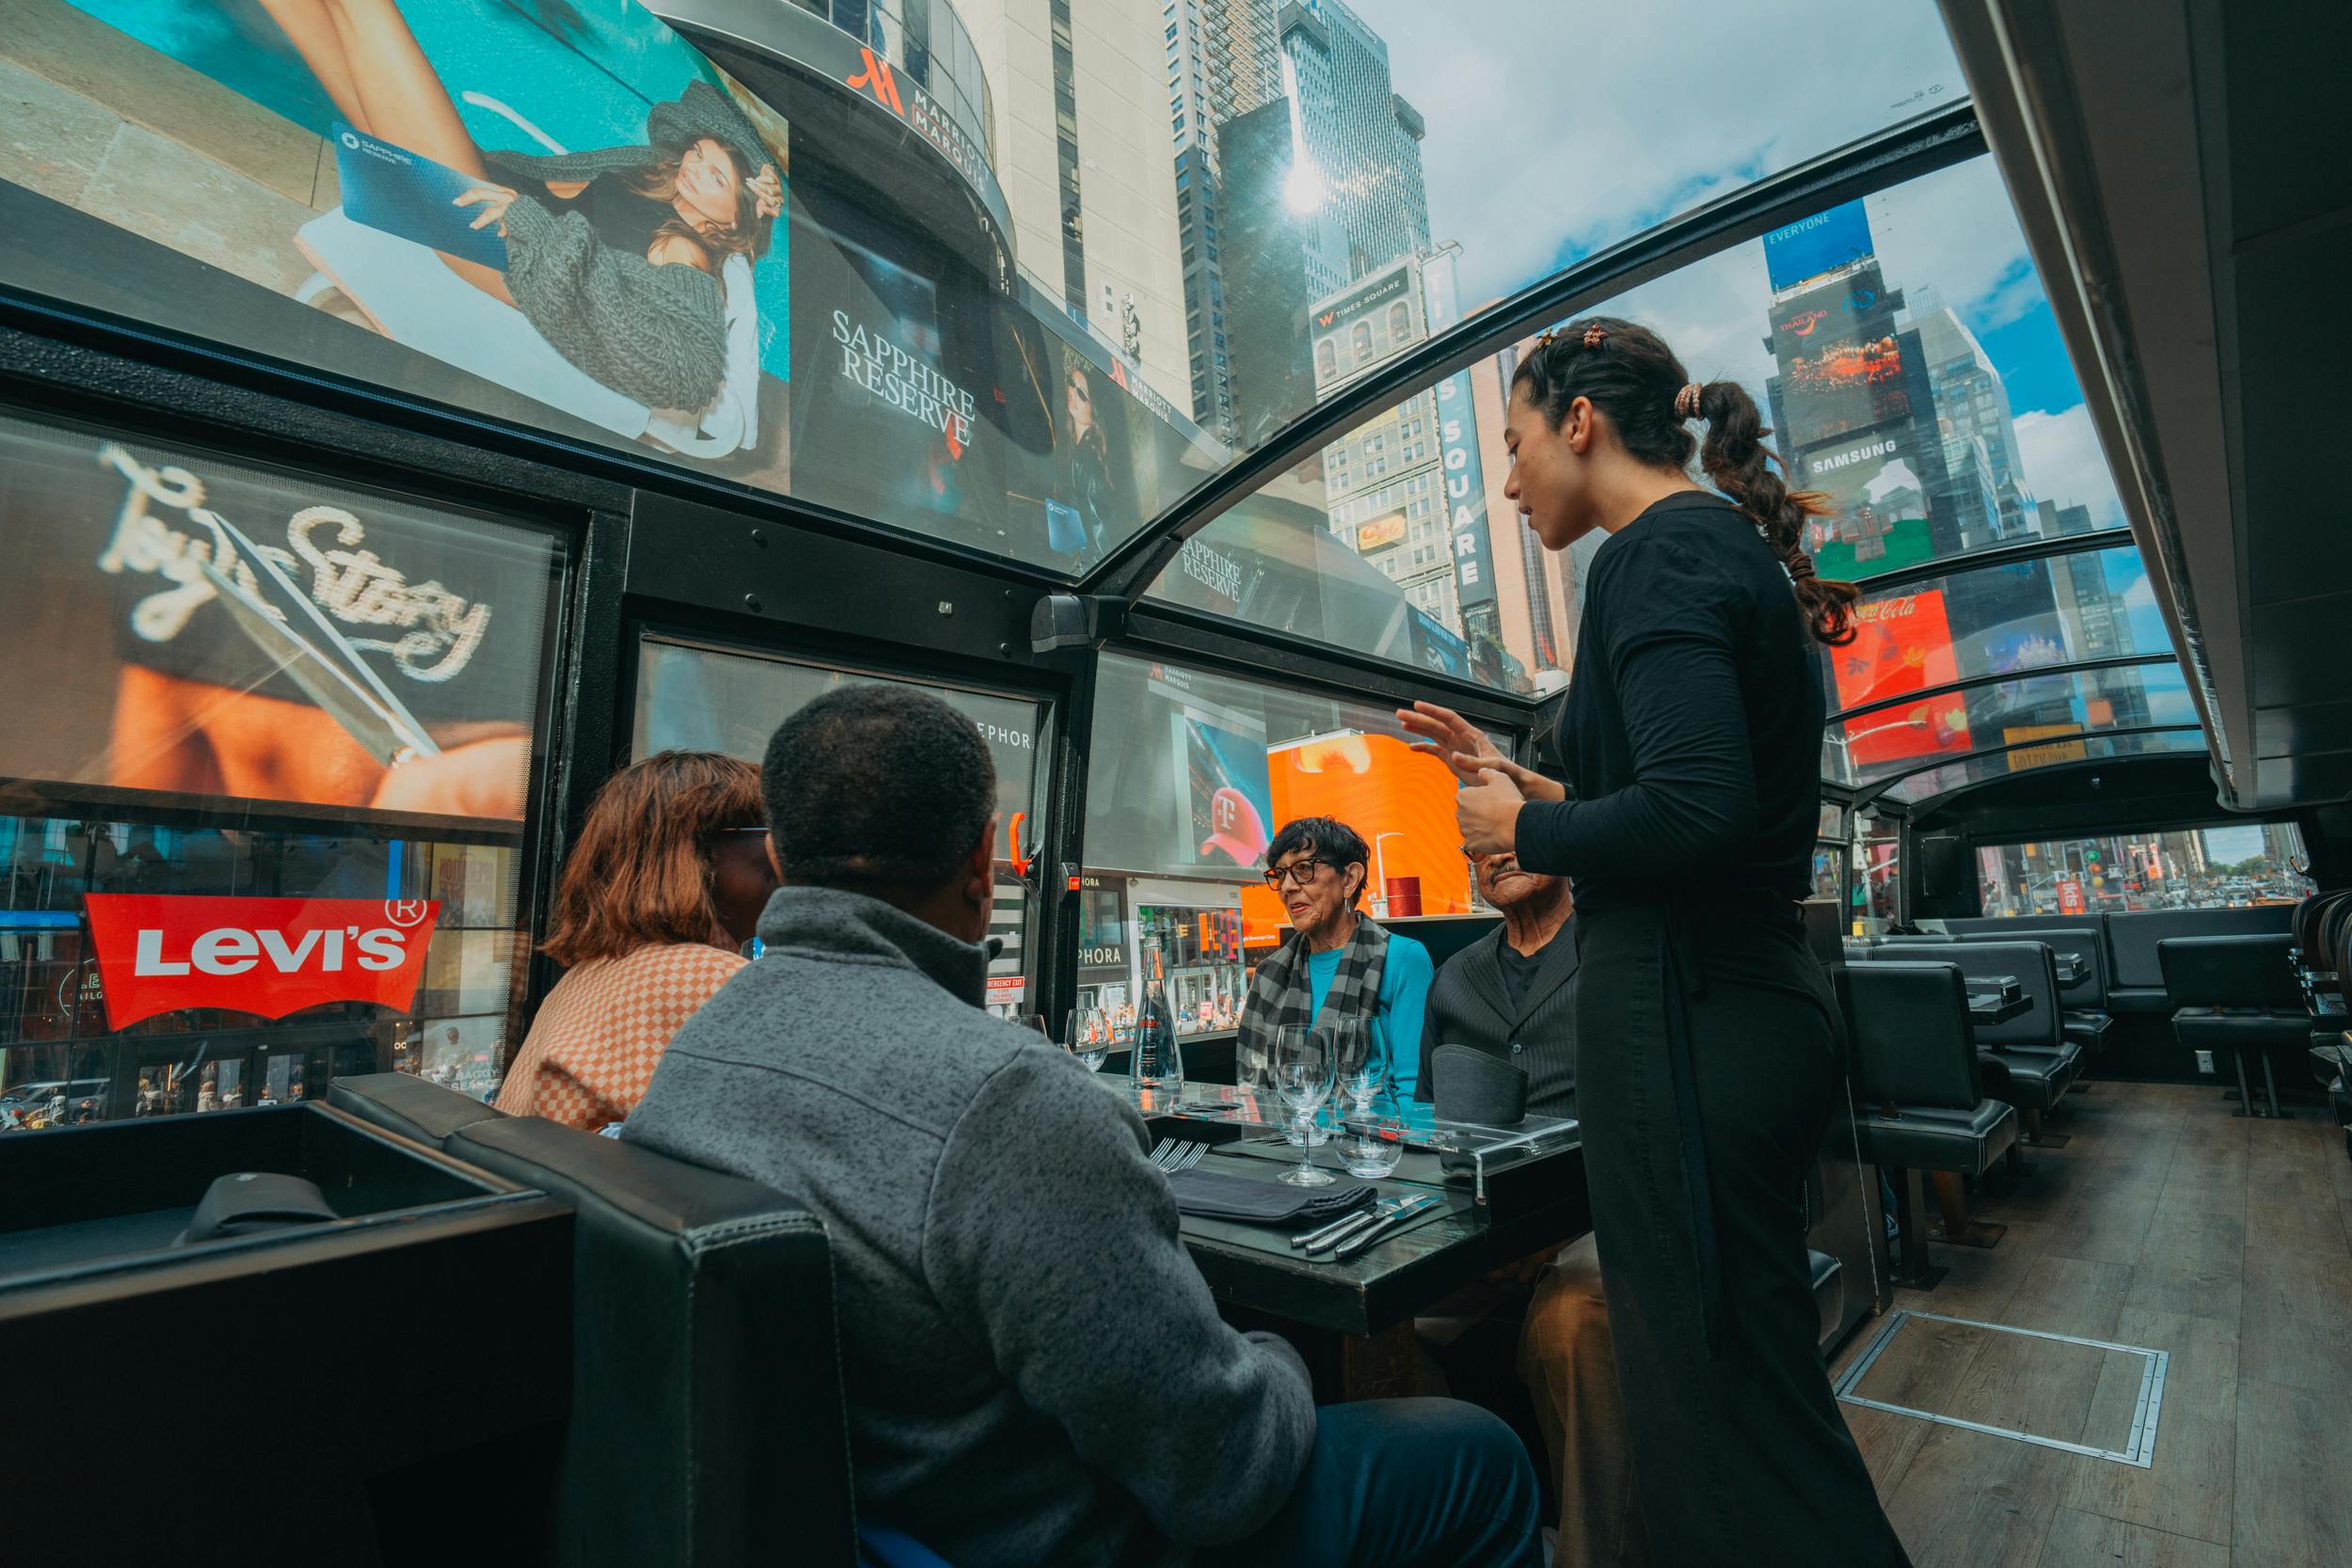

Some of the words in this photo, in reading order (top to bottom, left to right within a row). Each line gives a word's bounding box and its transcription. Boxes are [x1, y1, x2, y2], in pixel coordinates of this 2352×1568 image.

[915, 89, 989, 181] MARRIOTT
[915, 110, 985, 192] MARQUIS
[1769, 212, 1831, 245] EVERYONE
[1336, 301, 1362, 319] TIMES
[1363, 280, 1401, 305] SQUARE
[833, 309, 976, 422] SAPPHIRE
[841, 344, 970, 447] RESERVE
[1131, 375, 1172, 415] MARRIOTT
[1812, 439, 1897, 473] SAMSUNG
[1443, 420, 1479, 587] SQUARE
[1183, 551, 1240, 603] RESERVE
[977, 721, 1034, 750] EPHOR
